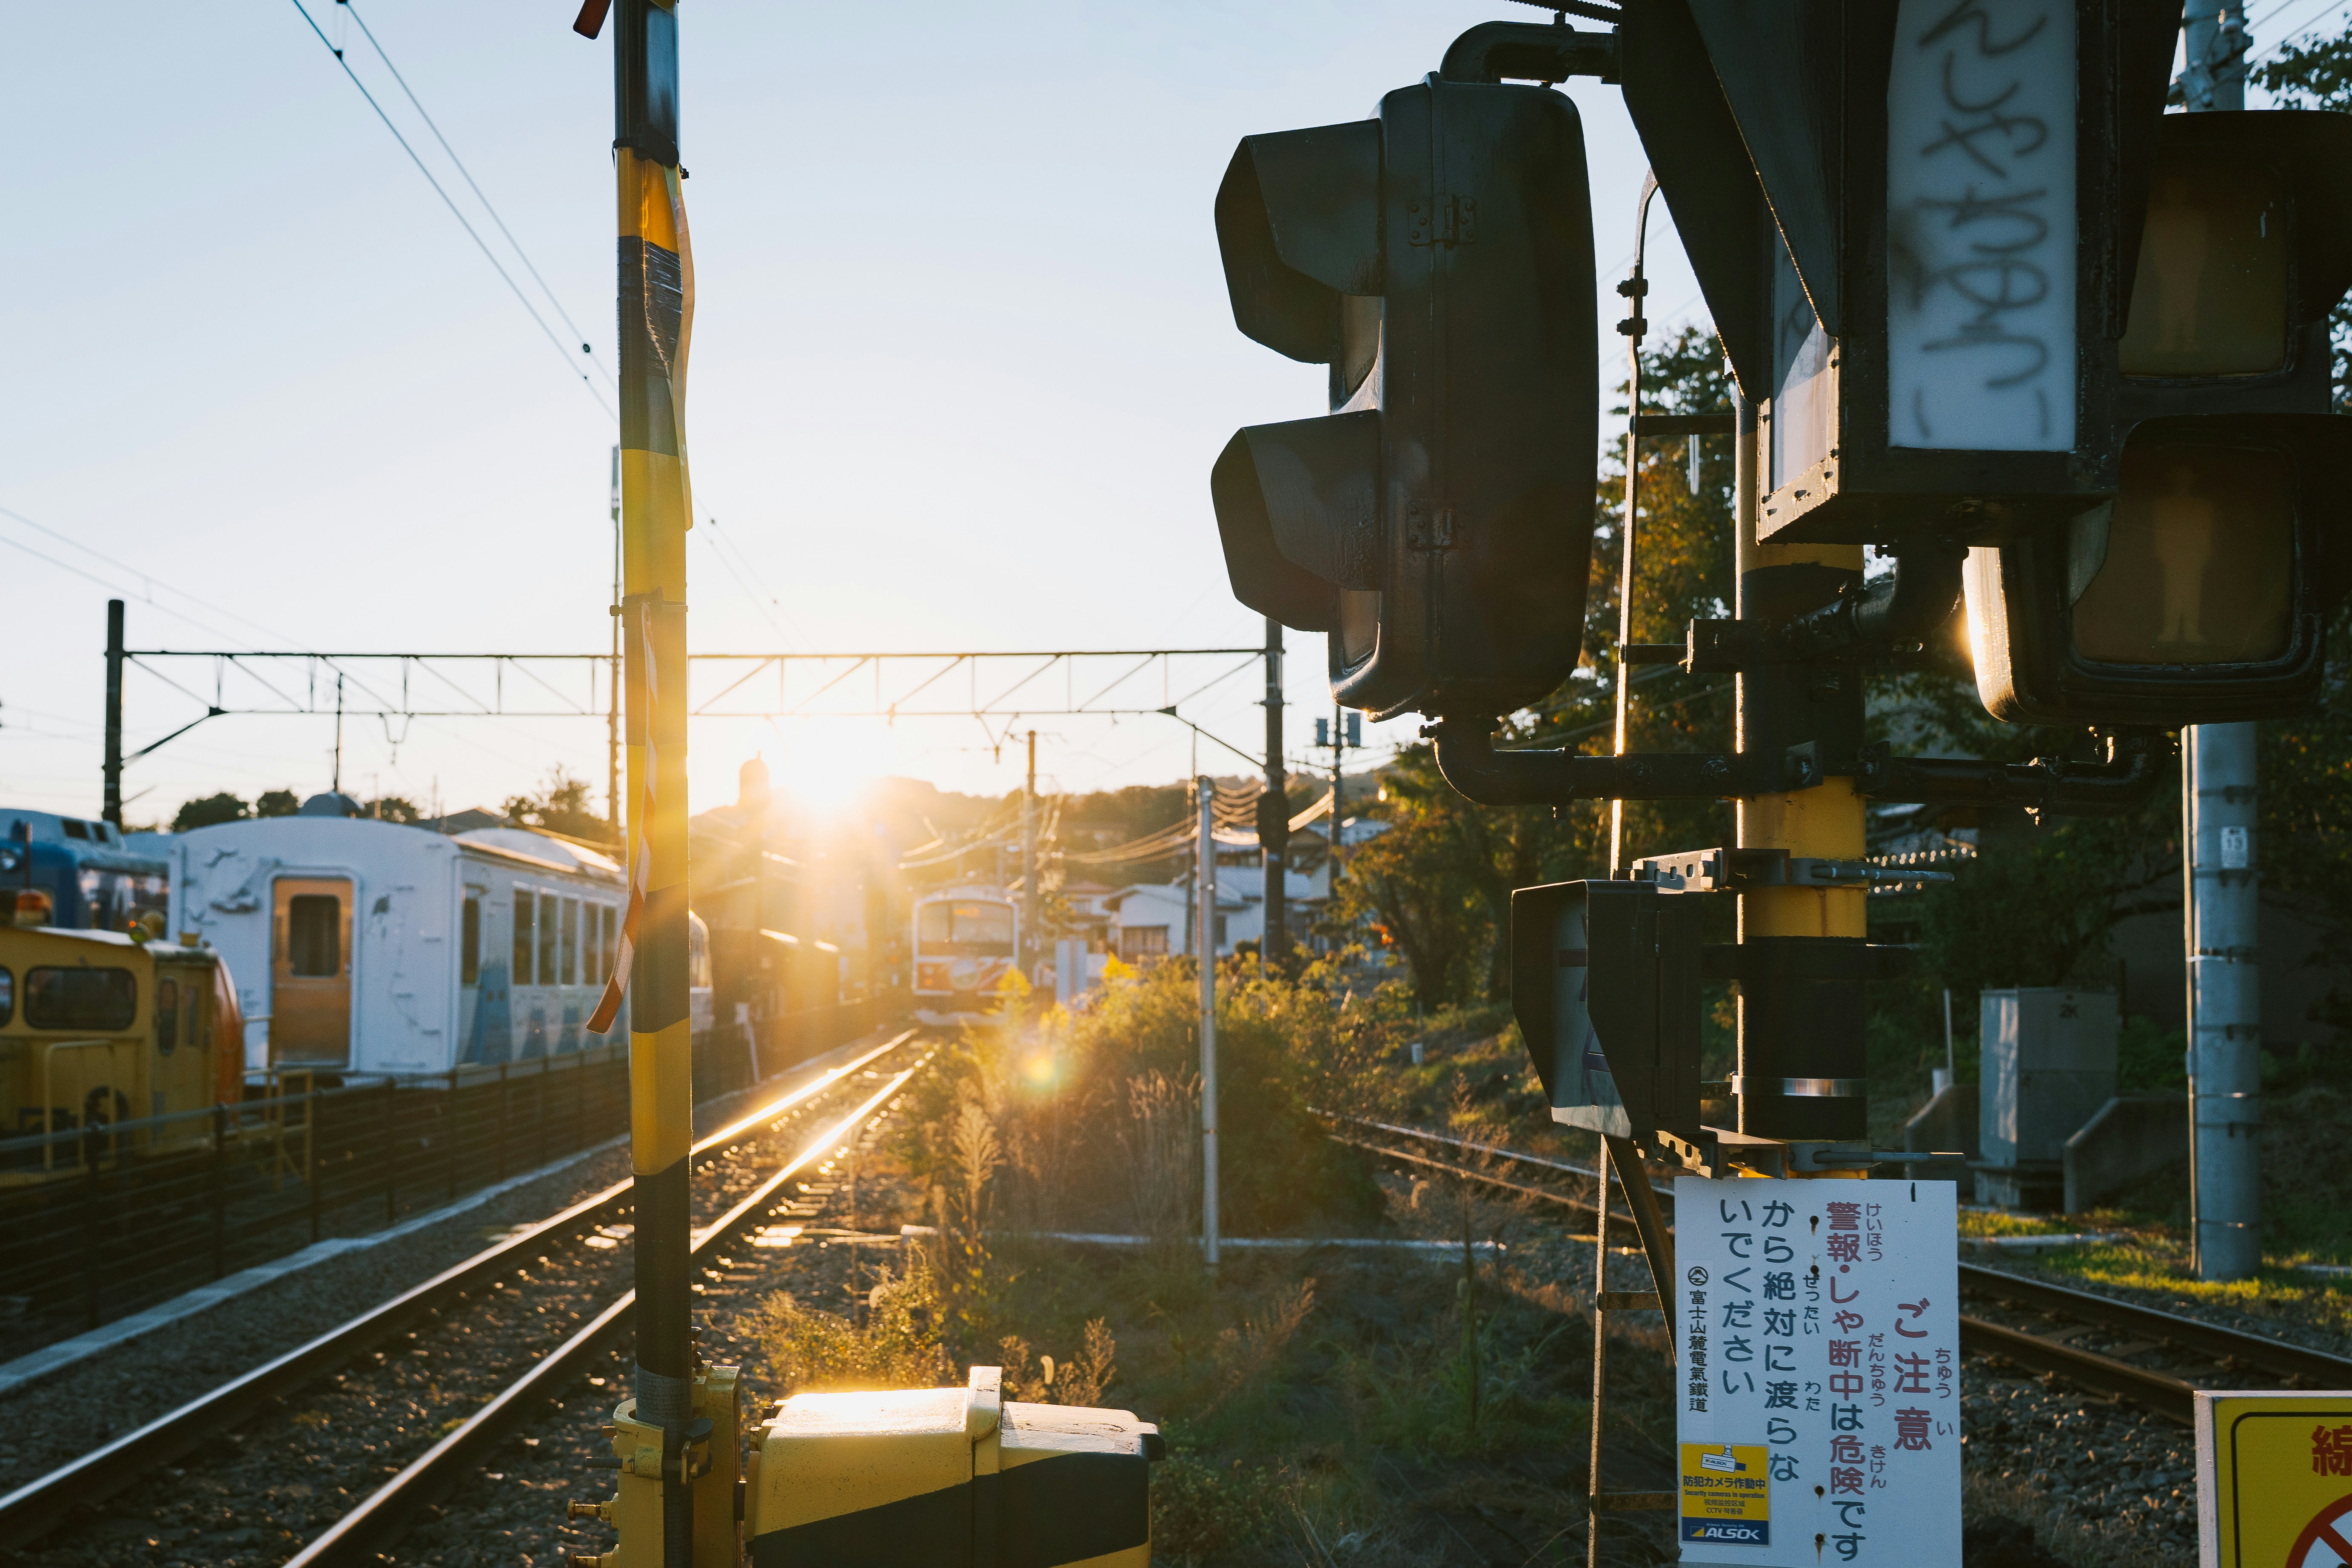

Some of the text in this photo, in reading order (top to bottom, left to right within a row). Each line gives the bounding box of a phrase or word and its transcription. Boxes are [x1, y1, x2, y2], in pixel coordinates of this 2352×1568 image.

[1866, 1203, 1883, 1262] けいほう
[1720, 1199, 1755, 1394] いでください
[1688, 1289, 1709, 1413] 富士山麓電氣鐵道
[1762, 1200, 1799, 1482] から絶対に渡らな
[1805, 1381, 1822, 1411] わた
[1893, 1297, 1932, 1450] ご注意
[1936, 1421, 1953, 1436] い
[1683, 1475, 1766, 1490] 防犯カメラ作動中
[1870, 1445, 1886, 1488] きけん
[1705, 1527, 1760, 1540] ALSOK
